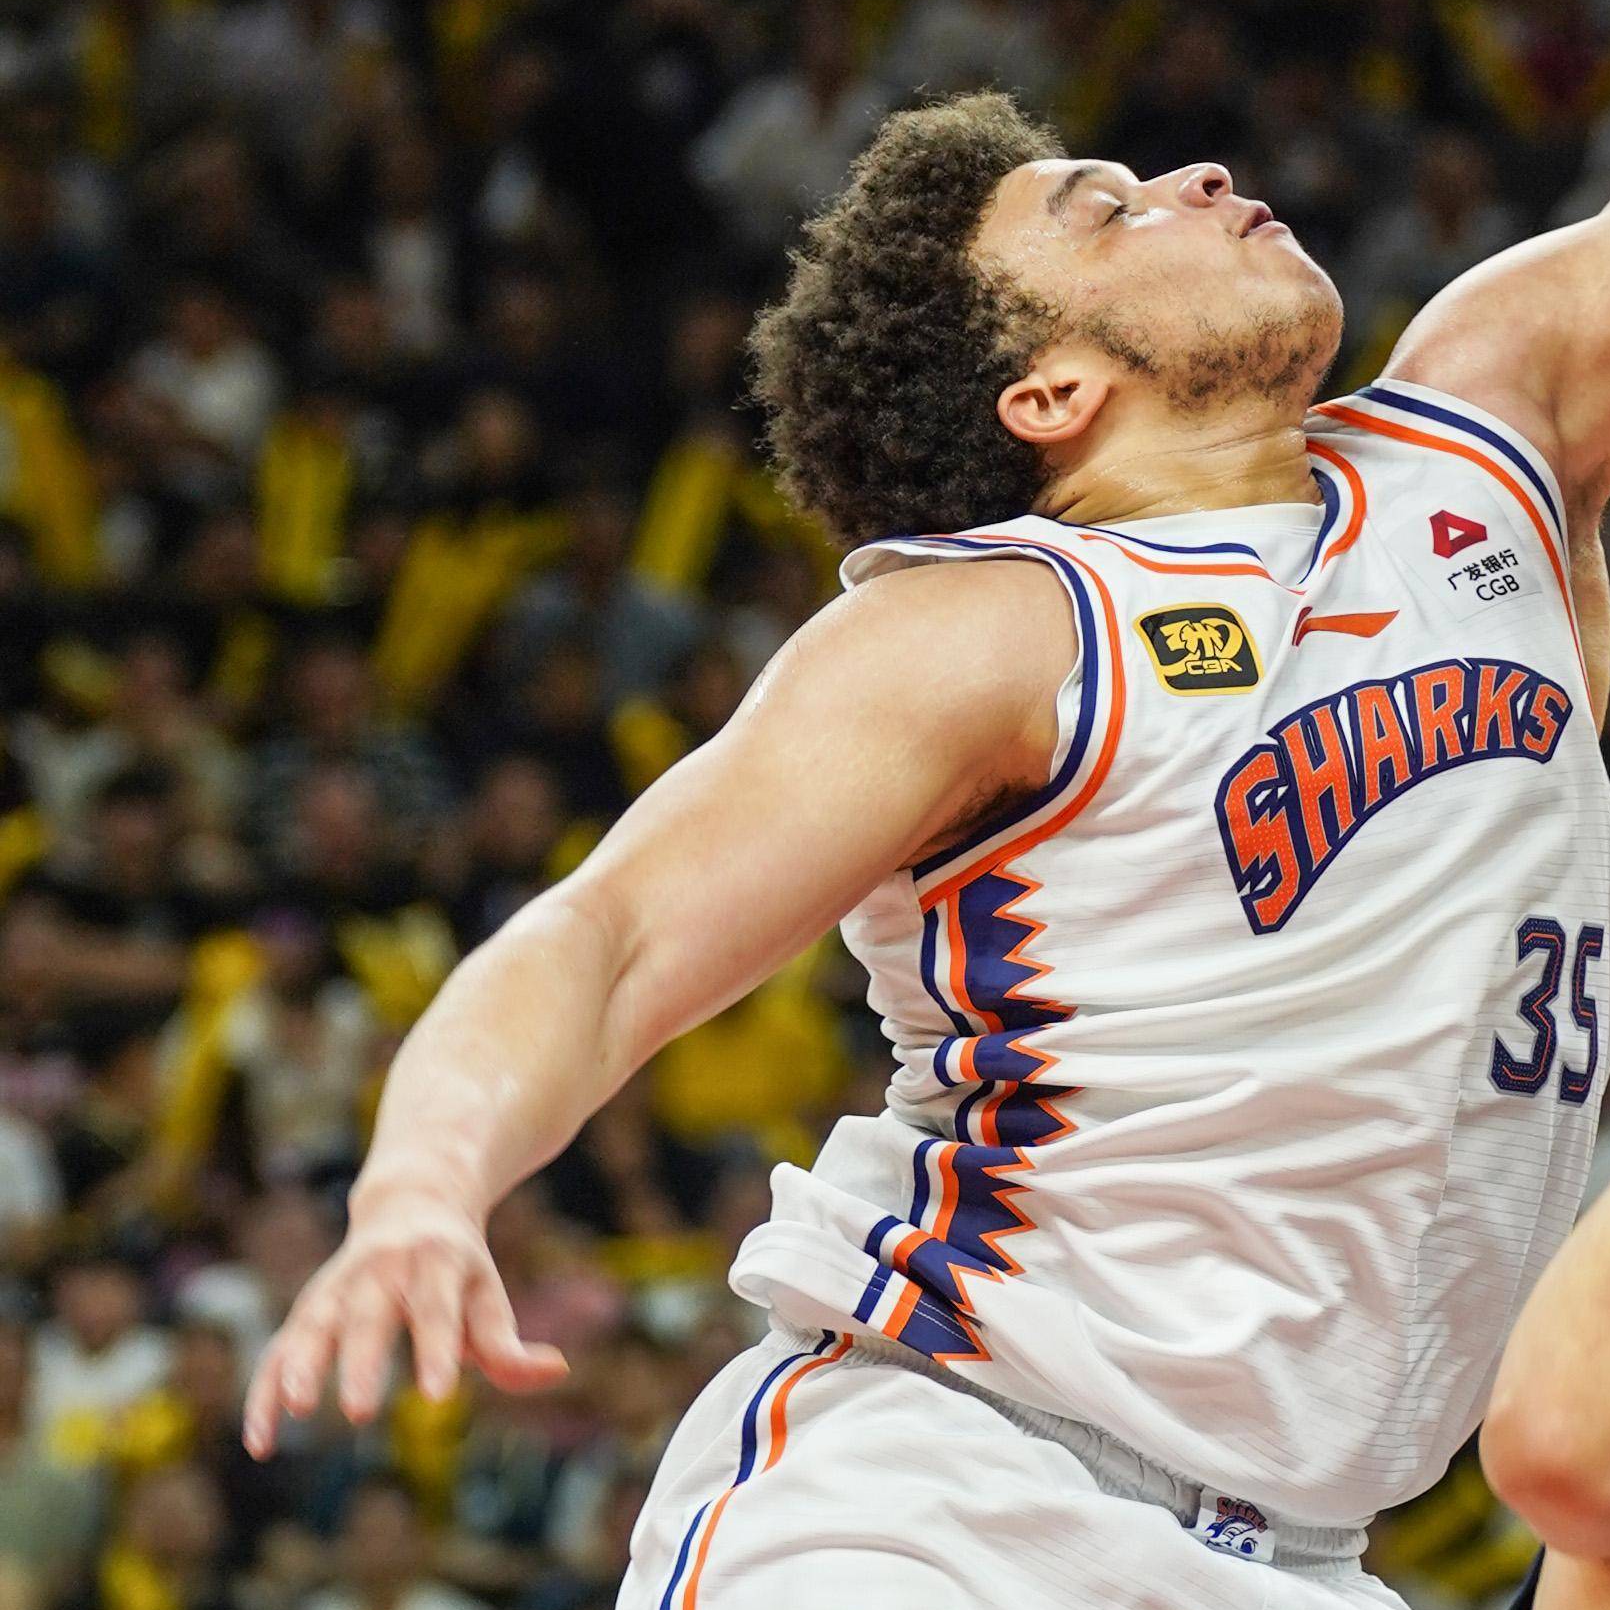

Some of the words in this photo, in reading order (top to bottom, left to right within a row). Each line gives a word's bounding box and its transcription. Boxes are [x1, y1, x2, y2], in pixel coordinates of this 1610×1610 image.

[1446, 549, 1519, 591] 广发银行
[1475, 574, 1520, 601] CGB
[1185, 659, 1243, 676] CBA
[1214, 657, 1574, 936] SHARKS
[1487, 914, 1605, 1108] 35
